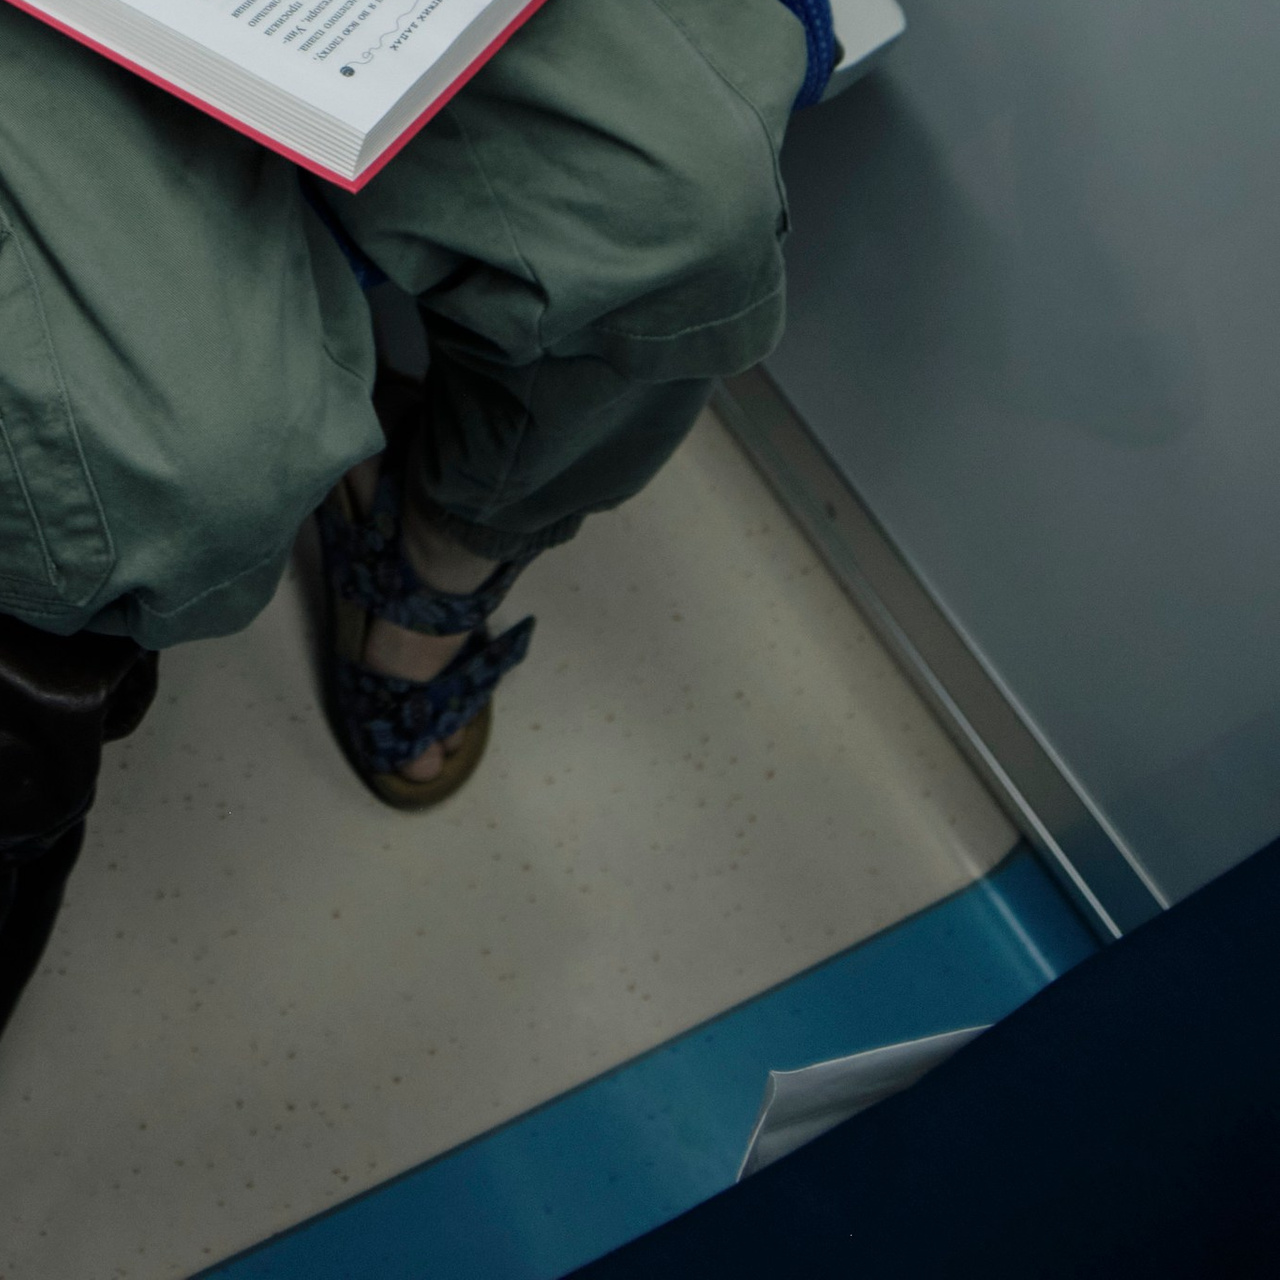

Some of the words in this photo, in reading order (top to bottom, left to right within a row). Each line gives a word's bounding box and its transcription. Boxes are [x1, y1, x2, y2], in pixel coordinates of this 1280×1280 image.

[263, 0, 304, 37] просияла
[357, 9, 371, 21] во
[341, 20, 360, 36] всю
